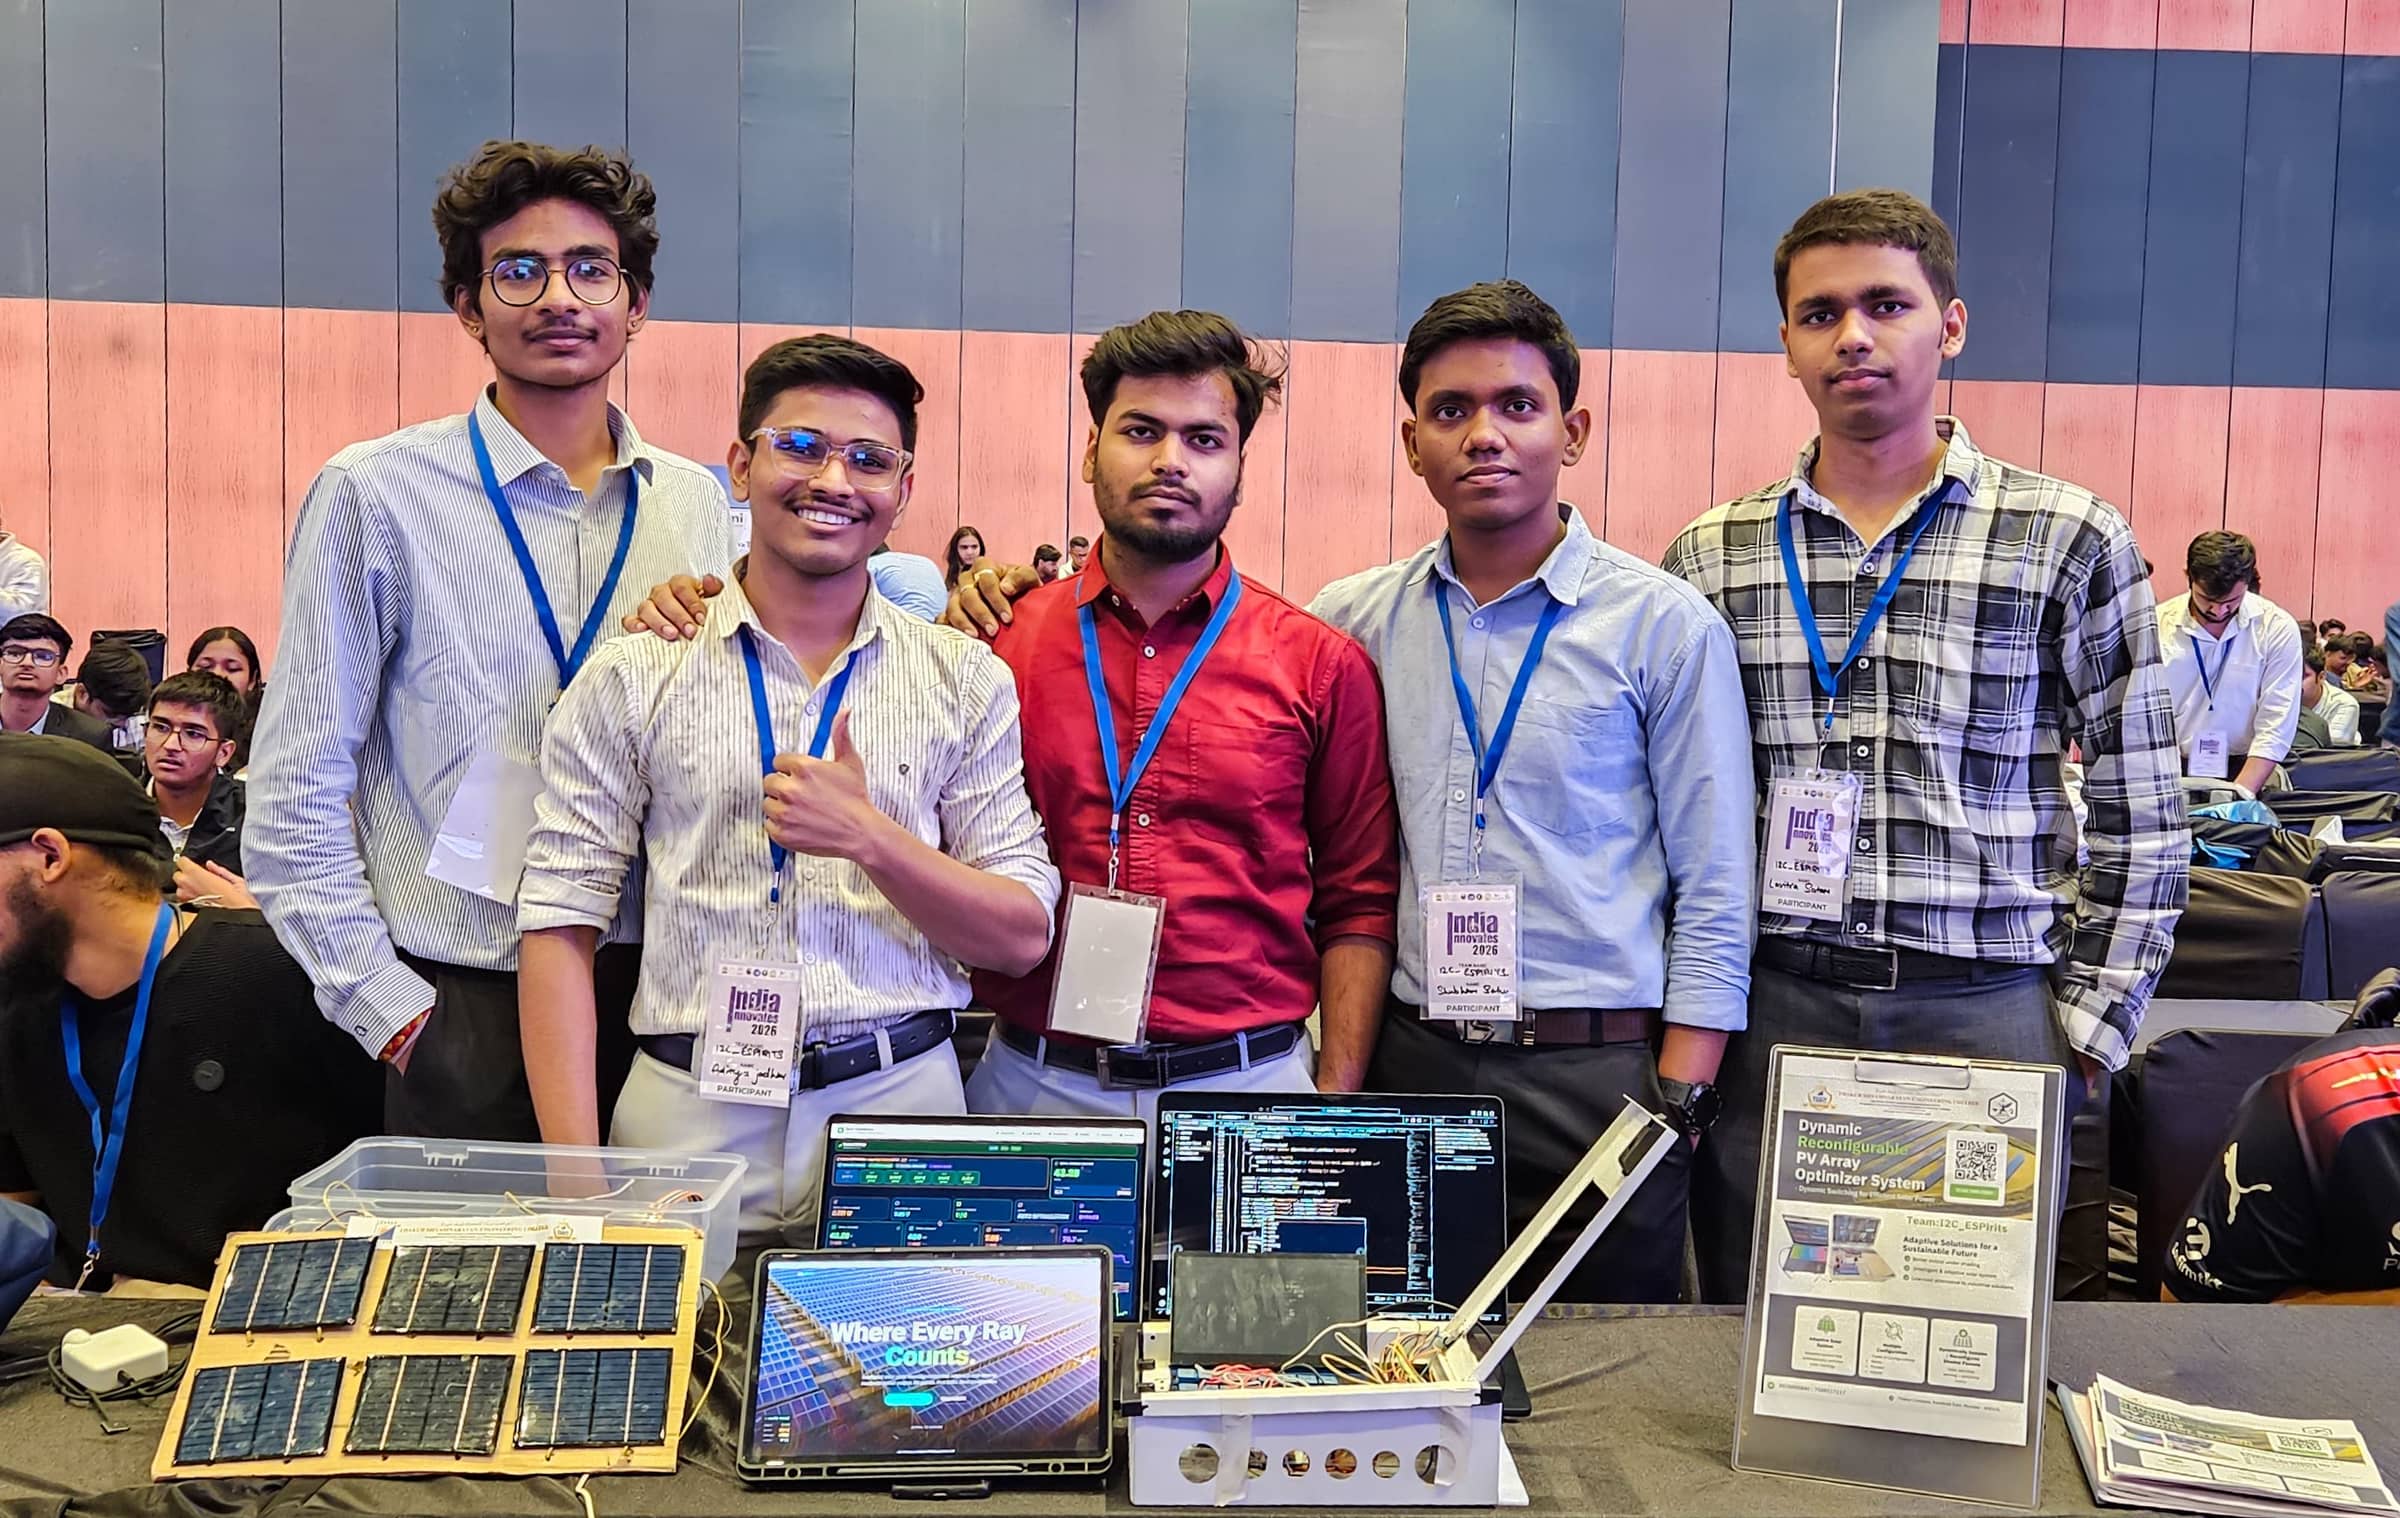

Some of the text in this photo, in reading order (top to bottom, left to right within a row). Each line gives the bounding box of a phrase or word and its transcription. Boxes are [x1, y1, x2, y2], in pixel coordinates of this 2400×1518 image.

[1777, 898, 1828, 911] PARTICIPANT
[1472, 945, 1499, 956] 2026
[1446, 1004, 1501, 1013] PARTICIPANT
[751, 1024, 778, 1037] 2026
[717, 1085, 772, 1097] PARTICIPANT
[1799, 1119, 1862, 1136] Dynamic
[1797, 1135, 1909, 1156] Reconfigurable
[1796, 1151, 1861, 1172] PV Array
[1794, 1168, 1926, 1192] Optimizer System
[1903, 1236, 1938, 1247] Adaptive
[1940, 1239, 1978, 1250] Solutions
[1903, 1245, 1978, 1258] Sustainable Future
[831, 1319, 1028, 1346] Where Every Ray
[885, 1346, 977, 1367] Counts.
